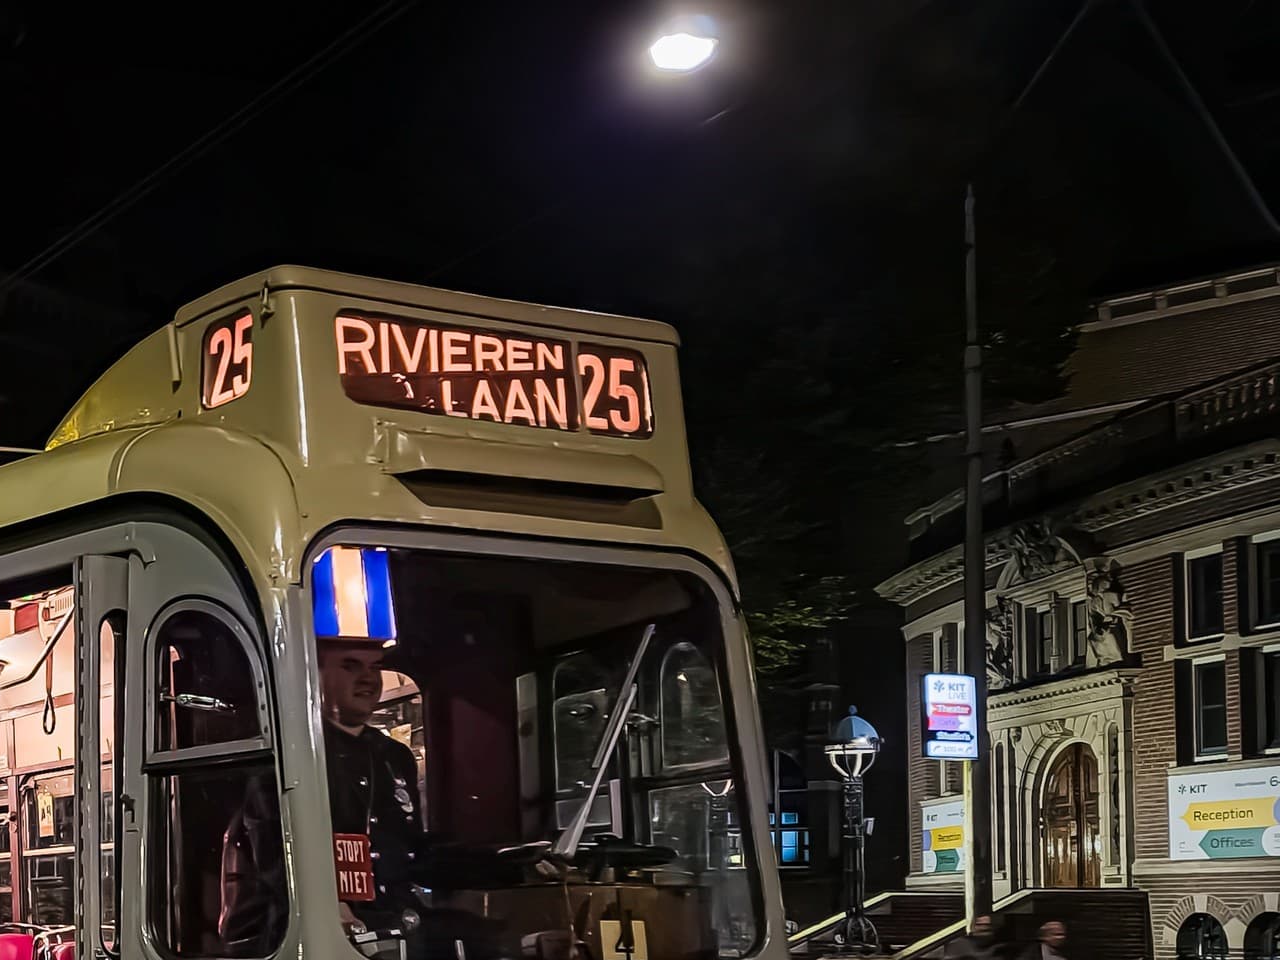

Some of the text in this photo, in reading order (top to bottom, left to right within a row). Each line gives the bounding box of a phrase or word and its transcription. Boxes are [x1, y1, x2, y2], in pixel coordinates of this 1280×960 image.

[335, 317, 564, 374] RIVIEREN
[208, 314, 253, 409] 25
[441, 377, 568, 429] LAAN
[578, 353, 641, 433] 25
[948, 683, 966, 692] KIT
[1189, 784, 1208, 794] KIT
[1193, 808, 1254, 822] Reception
[336, 839, 365, 863] STOPT
[1210, 836, 1255, 849] Offices
[339, 871, 369, 895] NIET
[615, 915, 635, 960] 4
